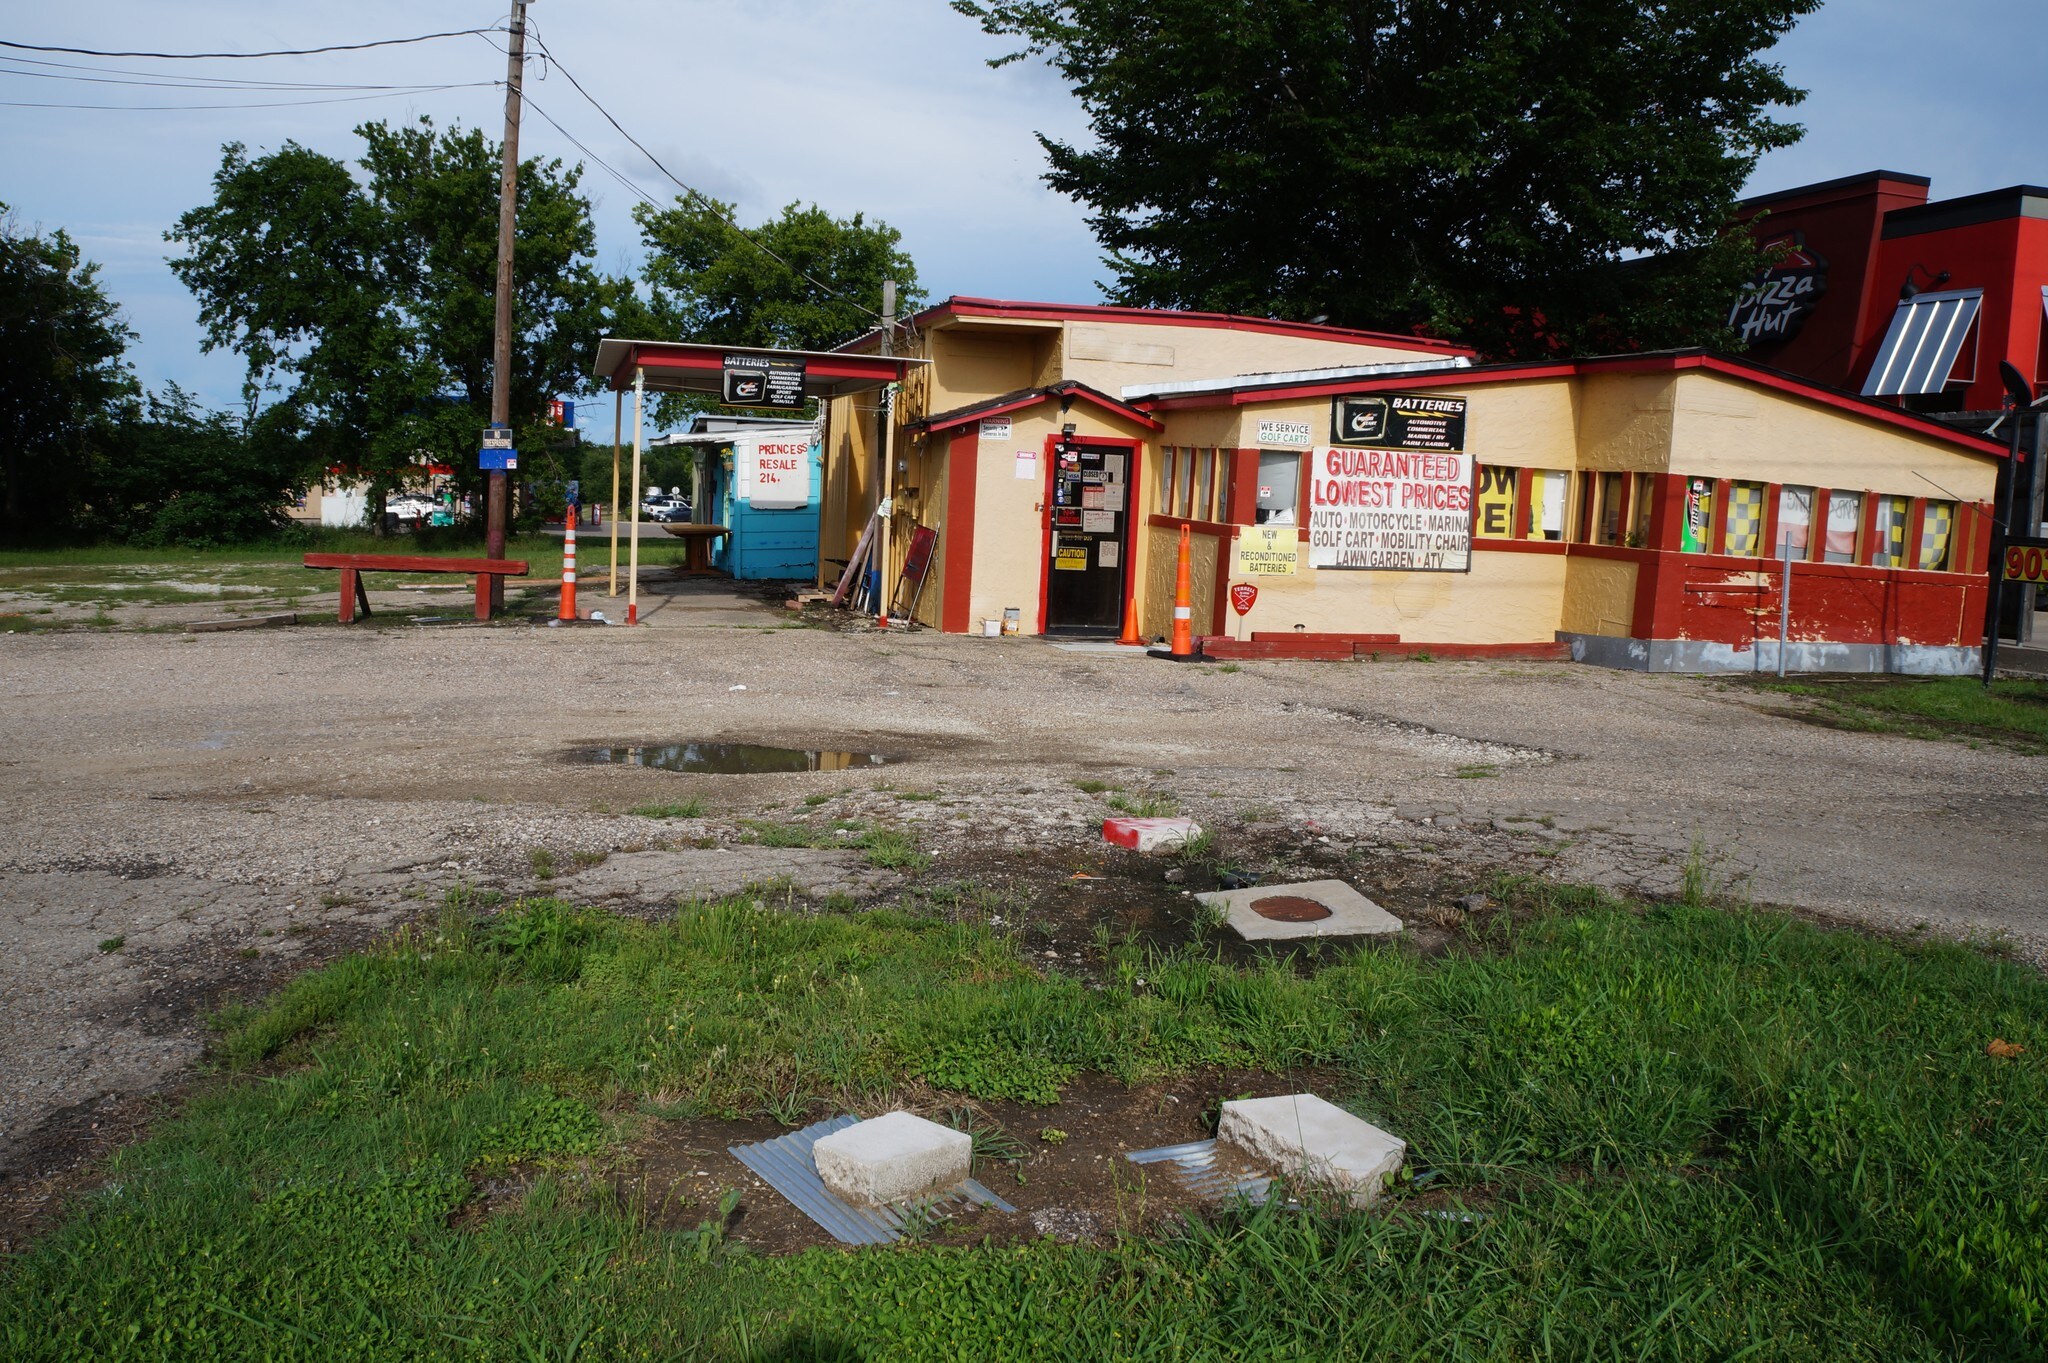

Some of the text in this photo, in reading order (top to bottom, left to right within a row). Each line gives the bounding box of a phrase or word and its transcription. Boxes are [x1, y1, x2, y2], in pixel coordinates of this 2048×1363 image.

[1741, 301, 1802, 343] Hut
[724, 356, 770, 367] BATTERIES
[1392, 397, 1465, 412] BATTERIES
[1260, 422, 1309, 434] WE SERVICE
[1260, 432, 1308, 443] GOLF CARTS
[758, 442, 808, 455] PRINCESS
[759, 459, 797, 470] RESALE
[1326, 449, 1460, 482] GUARANTEED
[1314, 479, 1471, 511] LOWEST PRICES
[1312, 511, 1343, 529] AUTO
[1349, 512, 1422, 531] MOTORCYCLE
[1428, 514, 1469, 532] MARINA
[1262, 529, 1278, 540] NEW
[1313, 530, 1469, 551] GOLF CART MOBILITY CHAIR
[1266, 541, 1272, 550] &
[1058, 548, 1085, 558] CAUTION
[1240, 551, 1297, 562] RECONDITIONED
[1336, 550, 1445, 569] LAWN/GARDEN ATV
[1249, 562, 1287, 573] BATTERIES
